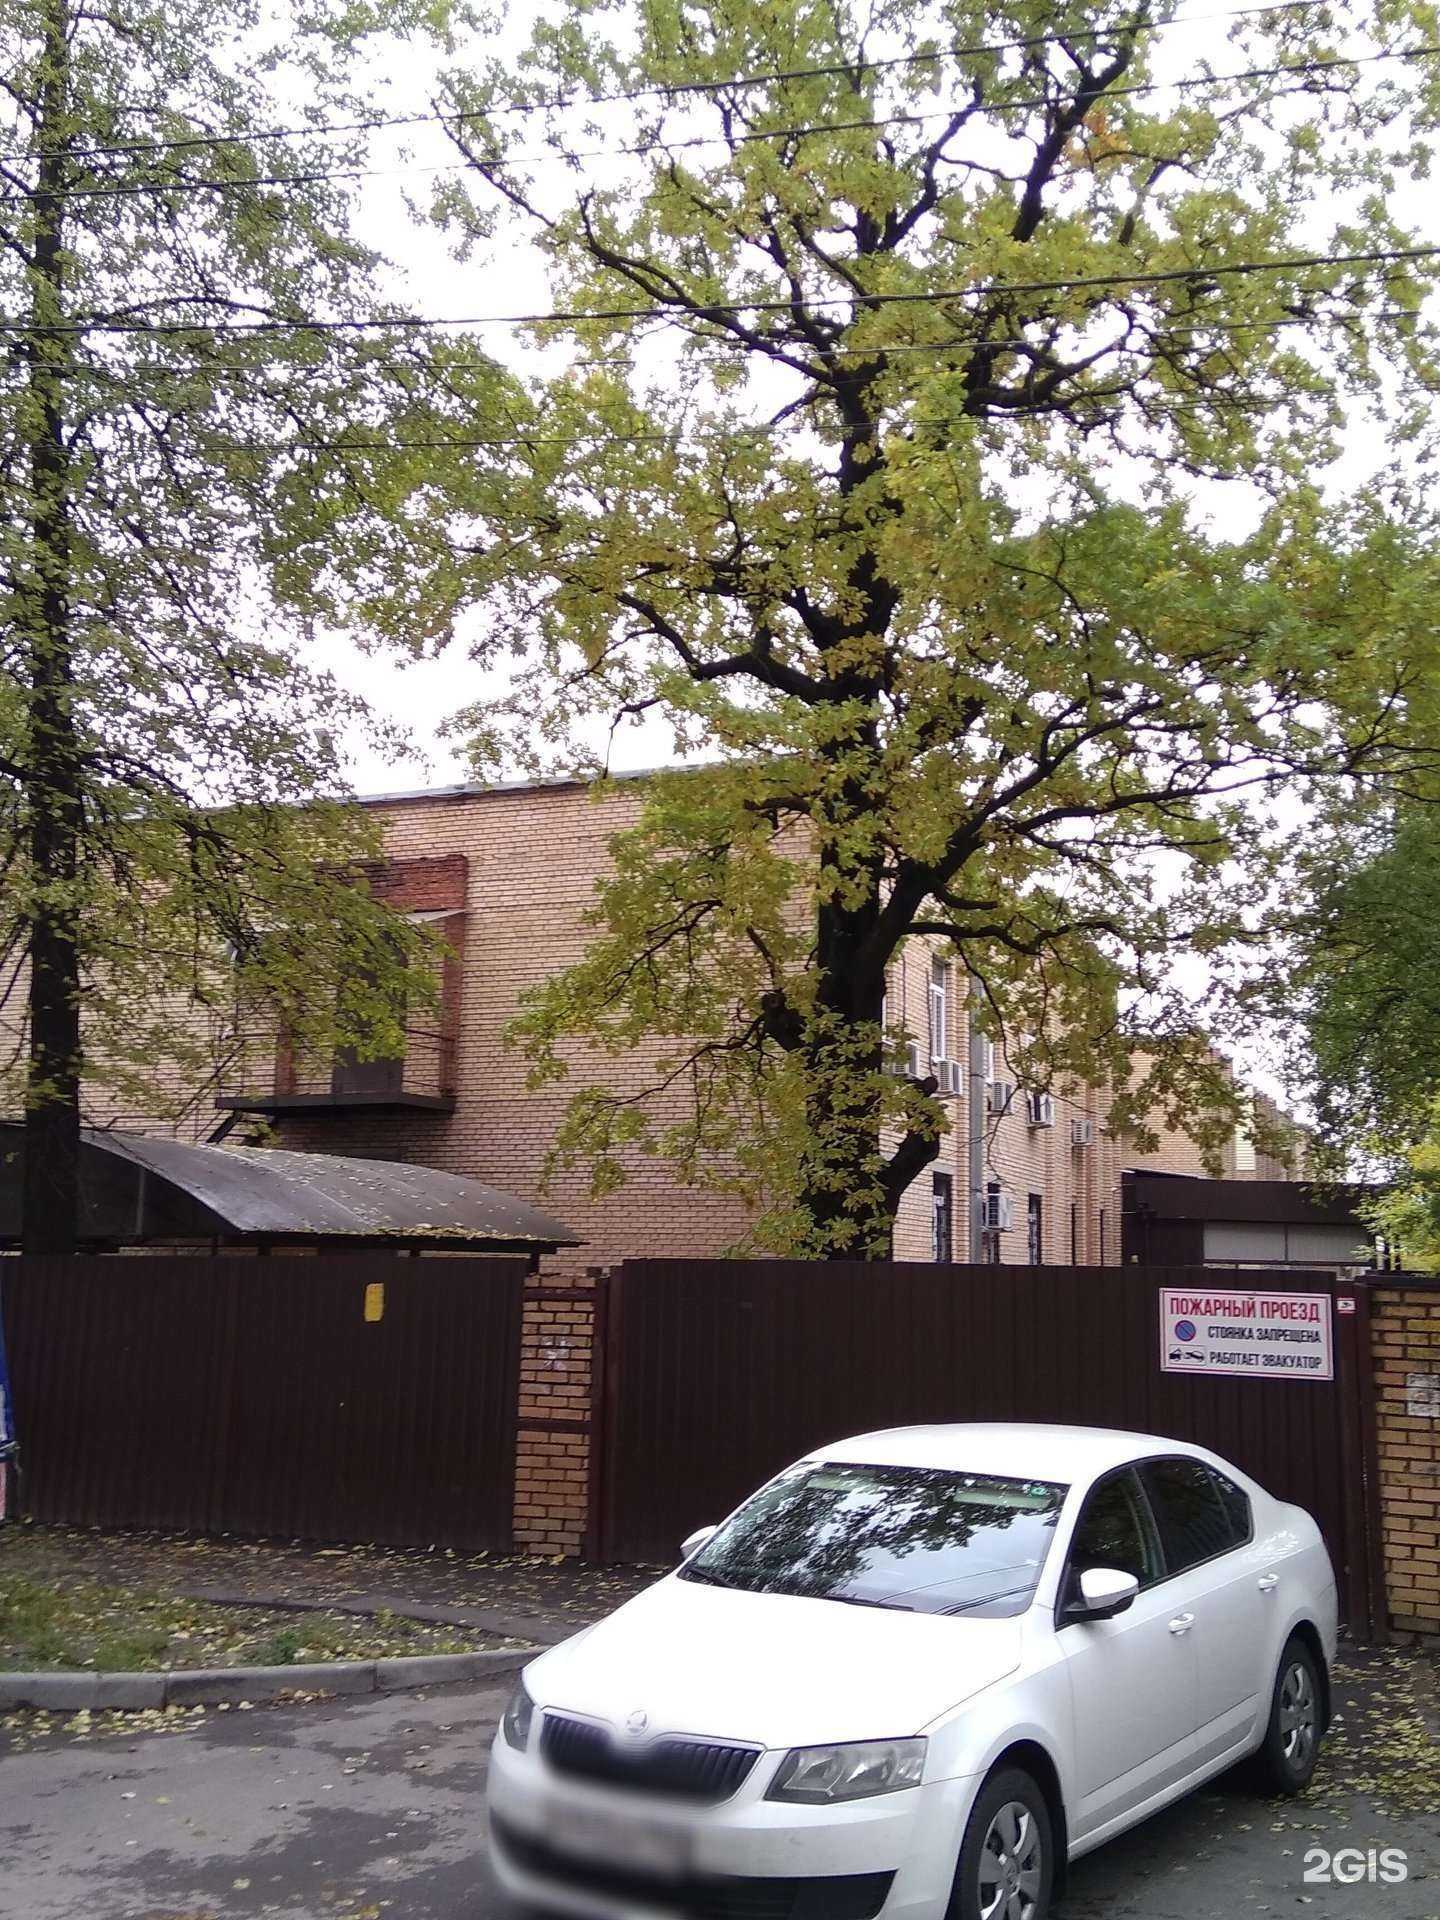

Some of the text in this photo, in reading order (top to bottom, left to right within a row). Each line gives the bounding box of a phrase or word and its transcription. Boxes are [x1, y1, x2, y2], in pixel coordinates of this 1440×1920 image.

[1170, 1297, 1320, 1323] ПОЖАРНЫЙ ПРОЕЗД
[1208, 1326, 1322, 1343] СТОЯНКА ЗАПРЕЩЕНА
[1210, 1351, 1322, 1369] РАБОТАЕТ ЭВАКУАТОР
